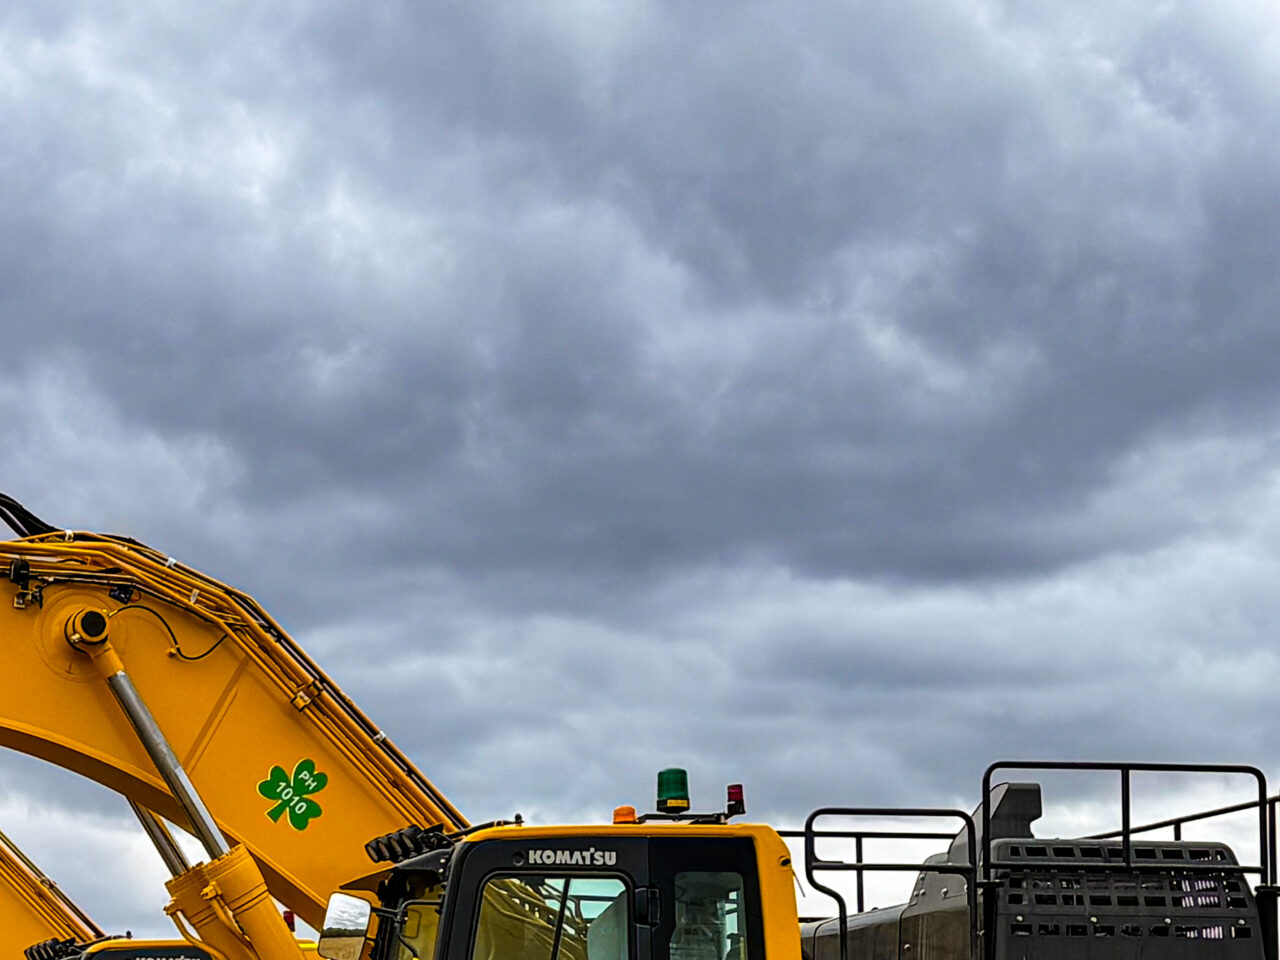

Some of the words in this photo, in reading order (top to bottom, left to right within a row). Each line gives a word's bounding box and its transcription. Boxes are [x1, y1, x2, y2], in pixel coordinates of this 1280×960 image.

[298, 770, 317, 790] PH
[276, 782, 307, 814] 1010
[528, 847, 616, 865] KOMATSU
